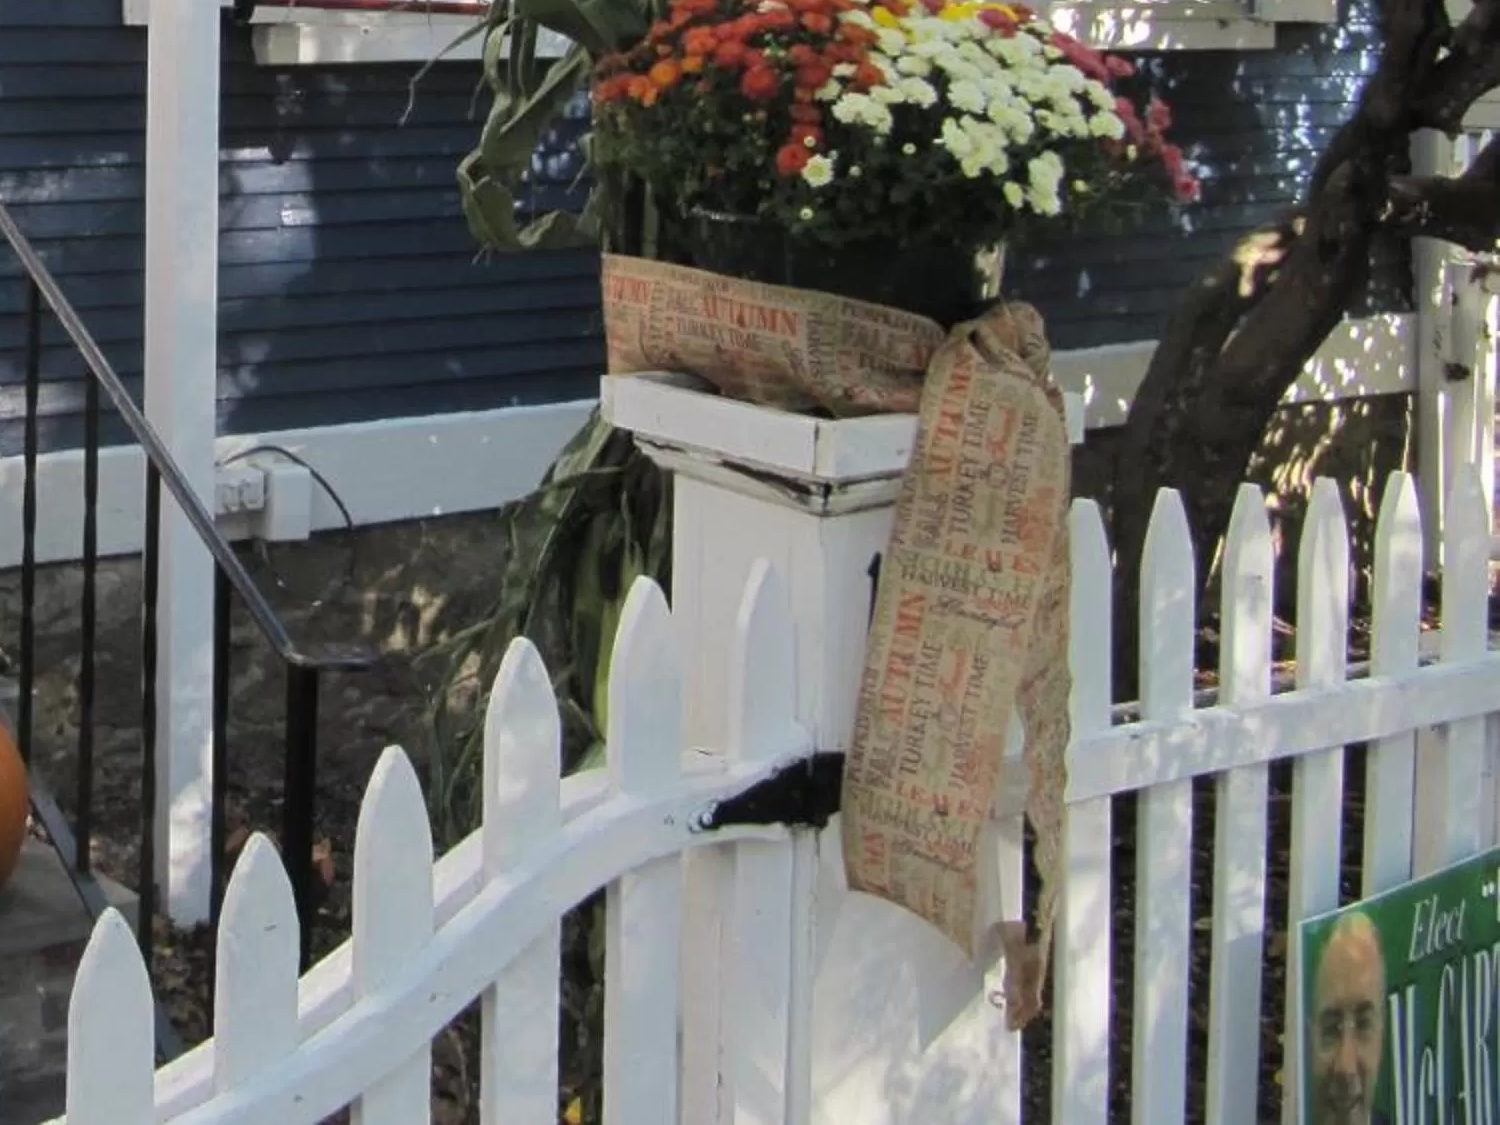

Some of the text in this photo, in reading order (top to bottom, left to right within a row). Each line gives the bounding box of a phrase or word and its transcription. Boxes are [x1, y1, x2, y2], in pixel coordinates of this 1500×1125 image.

[702, 294, 799, 338] AUTUMN
[924, 347, 976, 483] AUTUMN
[951, 397, 990, 534] TURKEY TIME
[1002, 412, 1038, 545] HARVEST TIME
[880, 592, 927, 727] AUTUMN
[900, 640, 943, 774] TURKEY TIME
[964, 652, 989, 698] TIME
[1408, 893, 1466, 962] Elect
